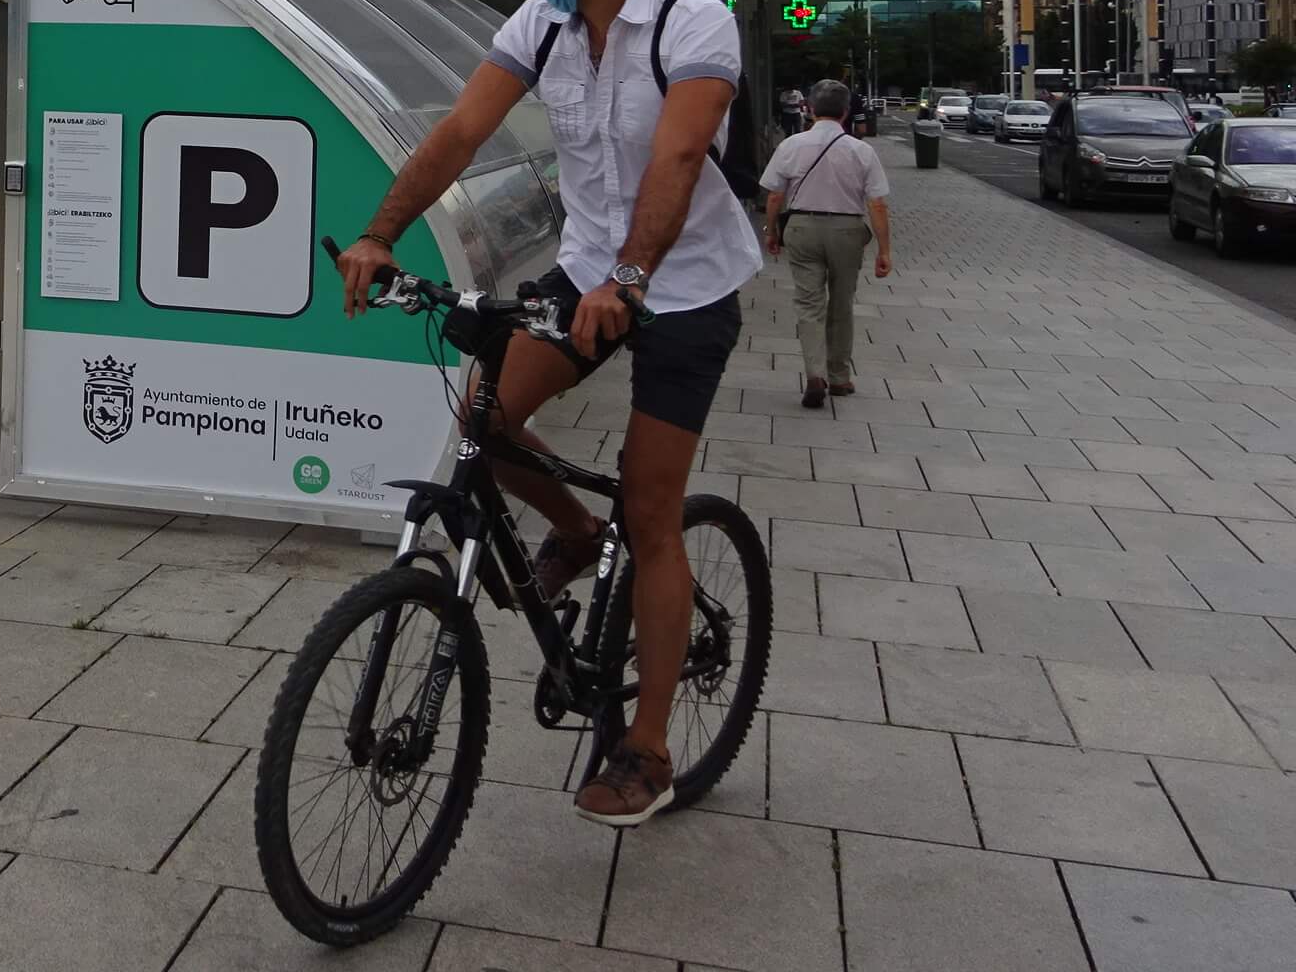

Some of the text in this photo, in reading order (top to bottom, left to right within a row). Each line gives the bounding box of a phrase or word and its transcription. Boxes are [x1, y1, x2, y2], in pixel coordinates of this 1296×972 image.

[48, 117, 66, 125] PARA
[177, 145, 279, 279] P
[143, 387, 266, 410] Ayuntamiento de
[142, 405, 266, 436] Pamplona
[285, 400, 383, 430] Iruñeko
[285, 426, 329, 443] Udala
[337, 488, 385, 501] STARDUST
